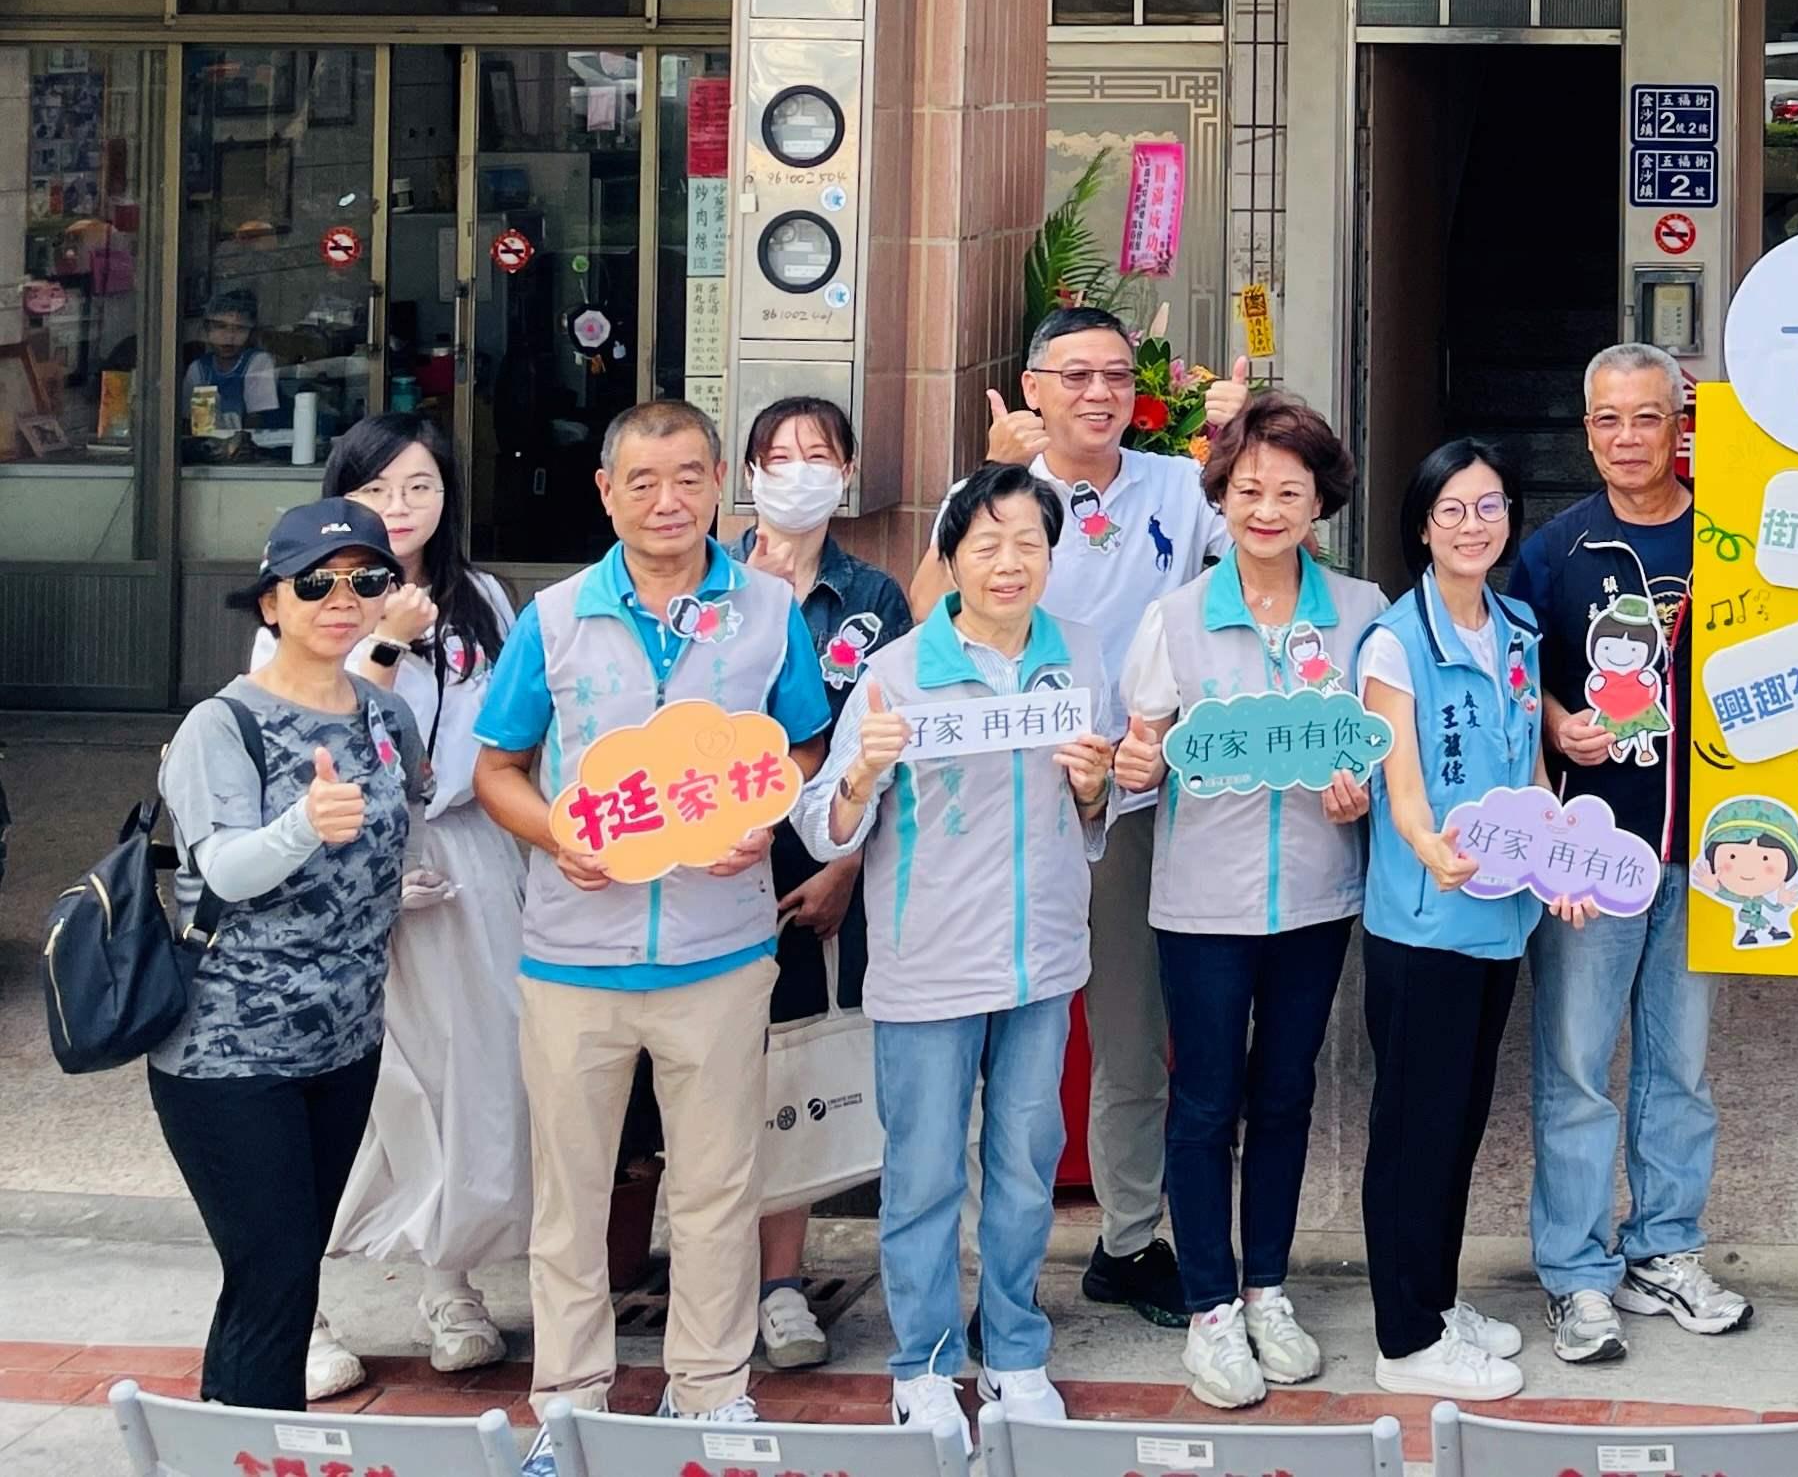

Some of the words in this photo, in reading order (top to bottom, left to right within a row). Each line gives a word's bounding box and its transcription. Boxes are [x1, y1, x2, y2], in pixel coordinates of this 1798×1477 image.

[981, 701, 1082, 739] 再有你
[1186, 730, 1248, 763] 好家
[1265, 717, 1362, 754] 再有你
[568, 751, 787, 851] 挺家扶
[1466, 820, 1533, 861] 好家
[1547, 832, 1646, 888] 再有你
